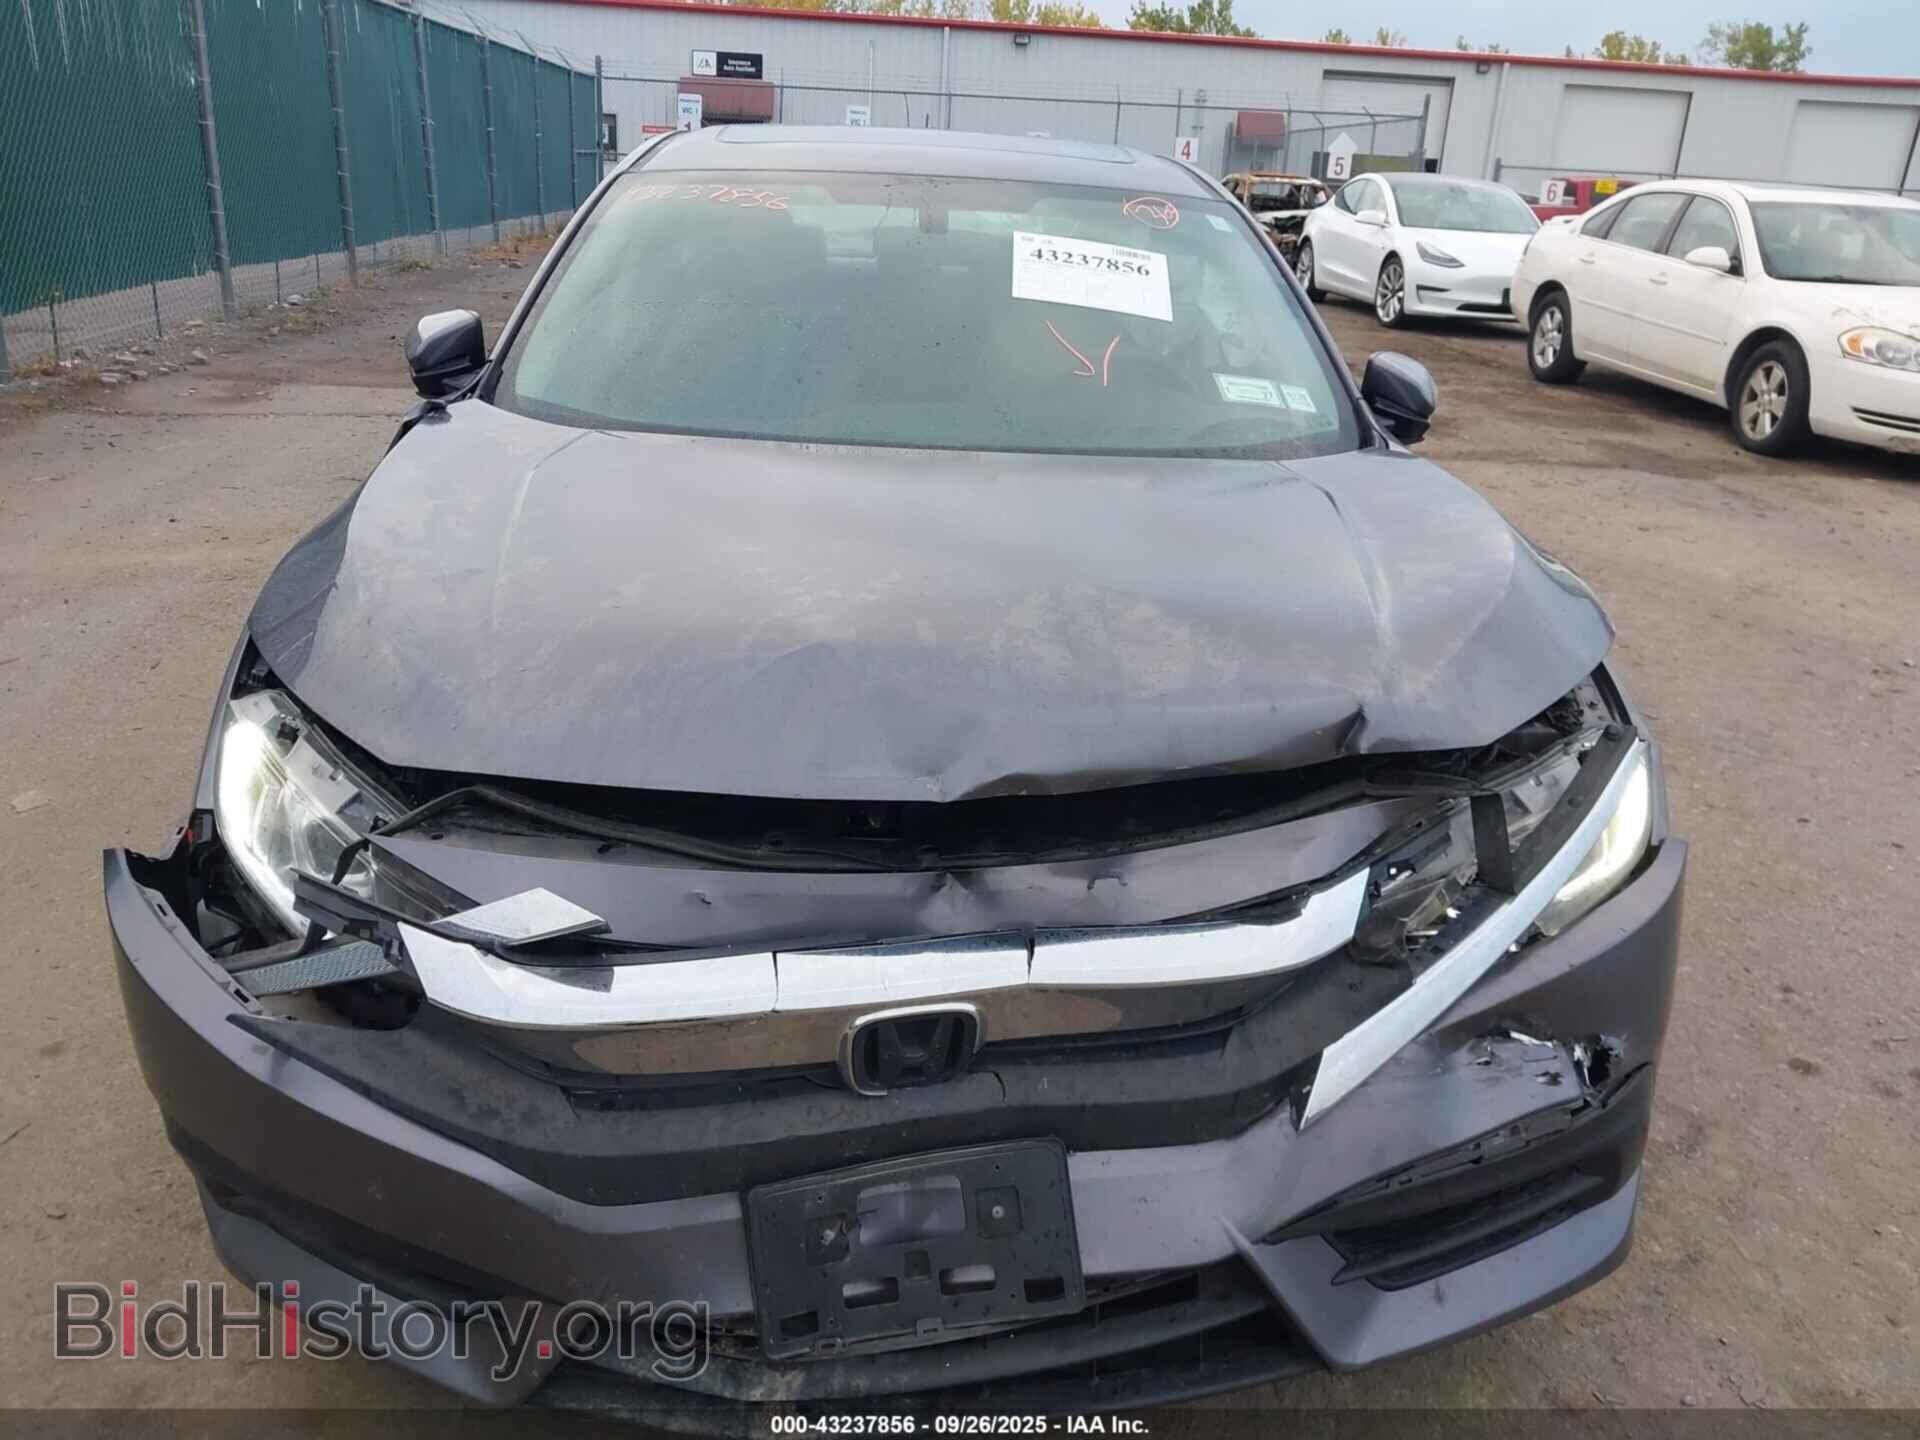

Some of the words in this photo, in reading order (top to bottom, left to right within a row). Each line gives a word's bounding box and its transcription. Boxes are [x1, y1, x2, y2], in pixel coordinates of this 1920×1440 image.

[1181, 140, 1191, 161] 4
[1334, 156, 1344, 176] 5
[1546, 183, 1558, 202] 6
[1030, 247, 1151, 277] 43237856
